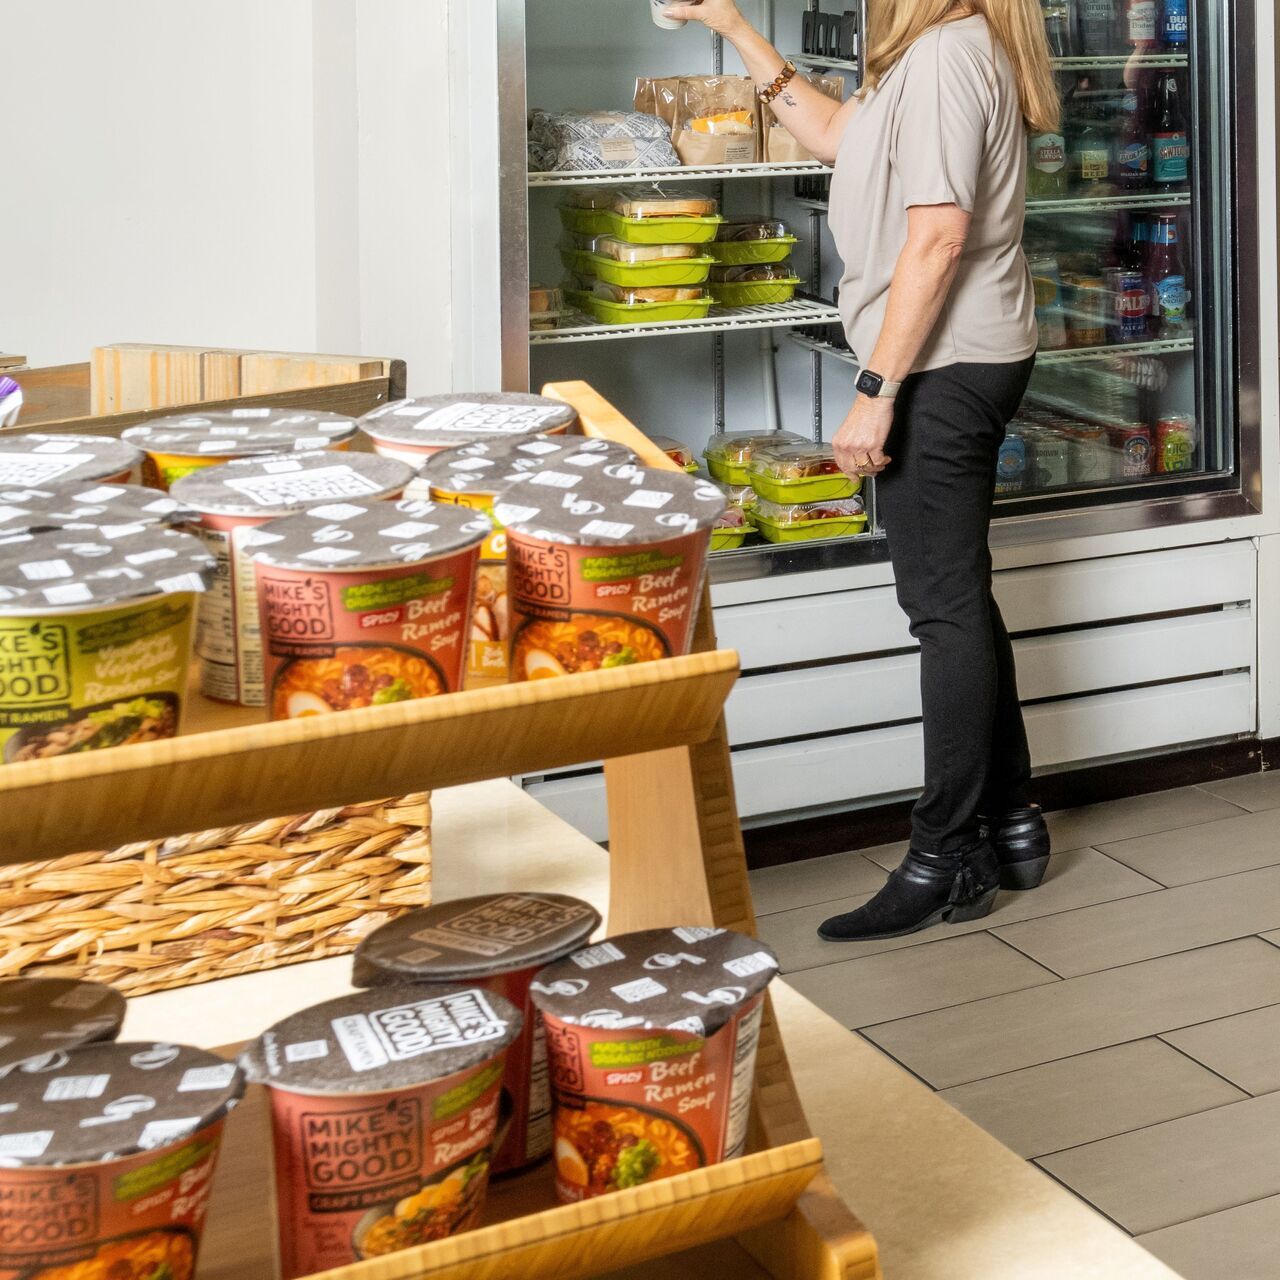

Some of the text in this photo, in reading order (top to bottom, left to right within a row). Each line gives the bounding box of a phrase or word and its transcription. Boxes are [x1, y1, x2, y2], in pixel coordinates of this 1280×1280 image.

[518, 546, 564, 567] MIKE'S
[263, 579, 324, 601] MIKE'S
[515, 580, 564, 599] GOOD
[596, 567, 681, 597] SPICY Beef
[267, 602, 325, 618] MIGHTY
[361, 591, 451, 627] SPICY Beef
[632, 586, 688, 612] Ramen
[269, 618, 326, 635] GOOD
[401, 612, 461, 640] Ramen
[659, 604, 686, 623] Soup
[0, 624, 58, 653] KE'S
[432, 631, 460, 651] Soup
[0, 656, 61, 673] GHTY
[0, 675, 60, 696] OD
[452, 917, 534, 940] GOOD
[380, 1009, 433, 1056] GOOD
[416, 1002, 464, 1044] MIGHTY
[606, 1053, 701, 1085] SPICY Beef
[644, 1072, 716, 1103] Ramen
[678, 1092, 716, 1114] Soup
[308, 1101, 415, 1138] MIKE'S
[310, 1128, 413, 1159] MIGHTY
[313, 1149, 412, 1184] GOOD
